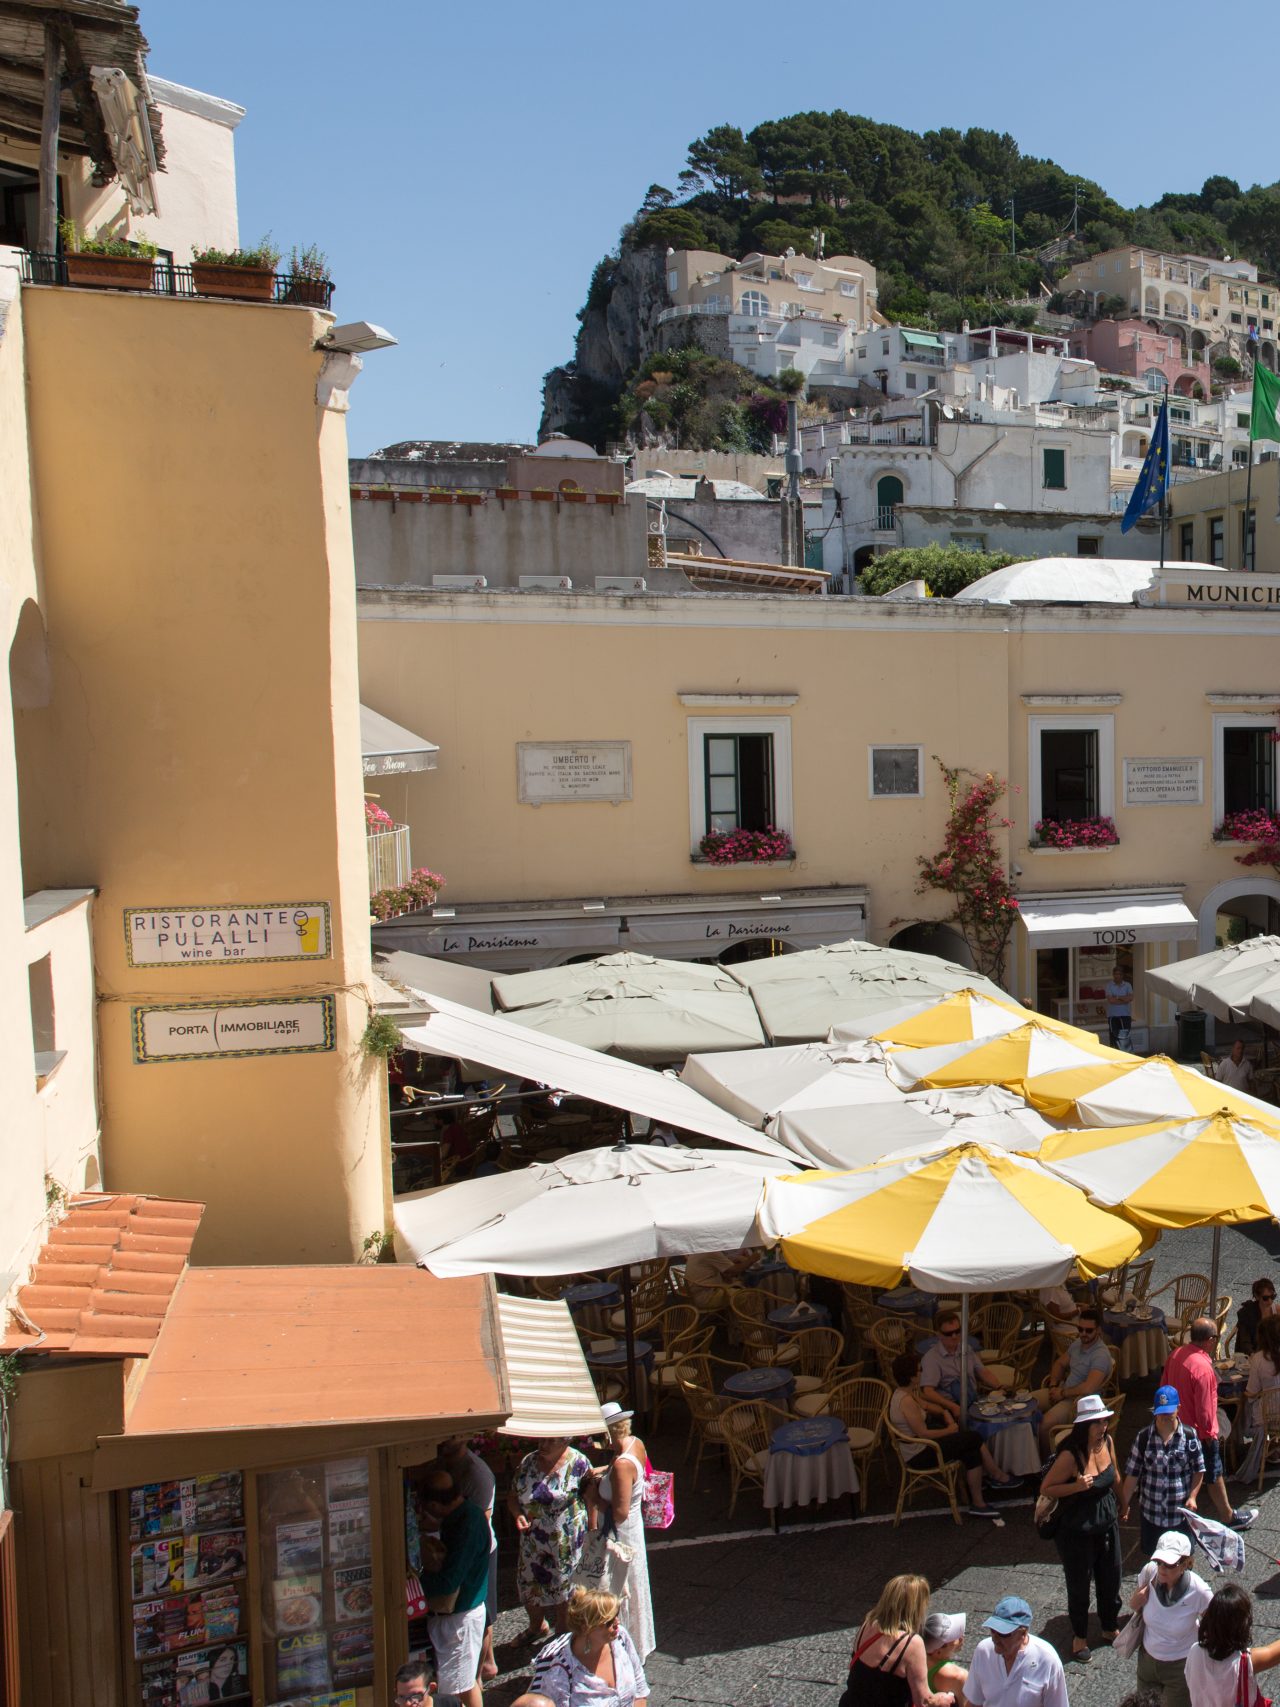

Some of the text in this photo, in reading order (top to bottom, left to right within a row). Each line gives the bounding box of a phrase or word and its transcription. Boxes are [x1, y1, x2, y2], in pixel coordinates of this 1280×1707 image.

[552, 755, 589, 764] UMBERTO
[135, 911, 288, 931] RISTORANTE
[158, 929, 269, 947] PULALLI
[706, 923, 792, 938] La Parisienne
[1093, 929, 1136, 945] TOD'S
[443, 936, 539, 952] La Parisienne
[181, 946, 246, 959] wine bar
[169, 1019, 300, 1036] PORTA IMMOBILIARE
[278, 1633, 322, 1652] CASE
